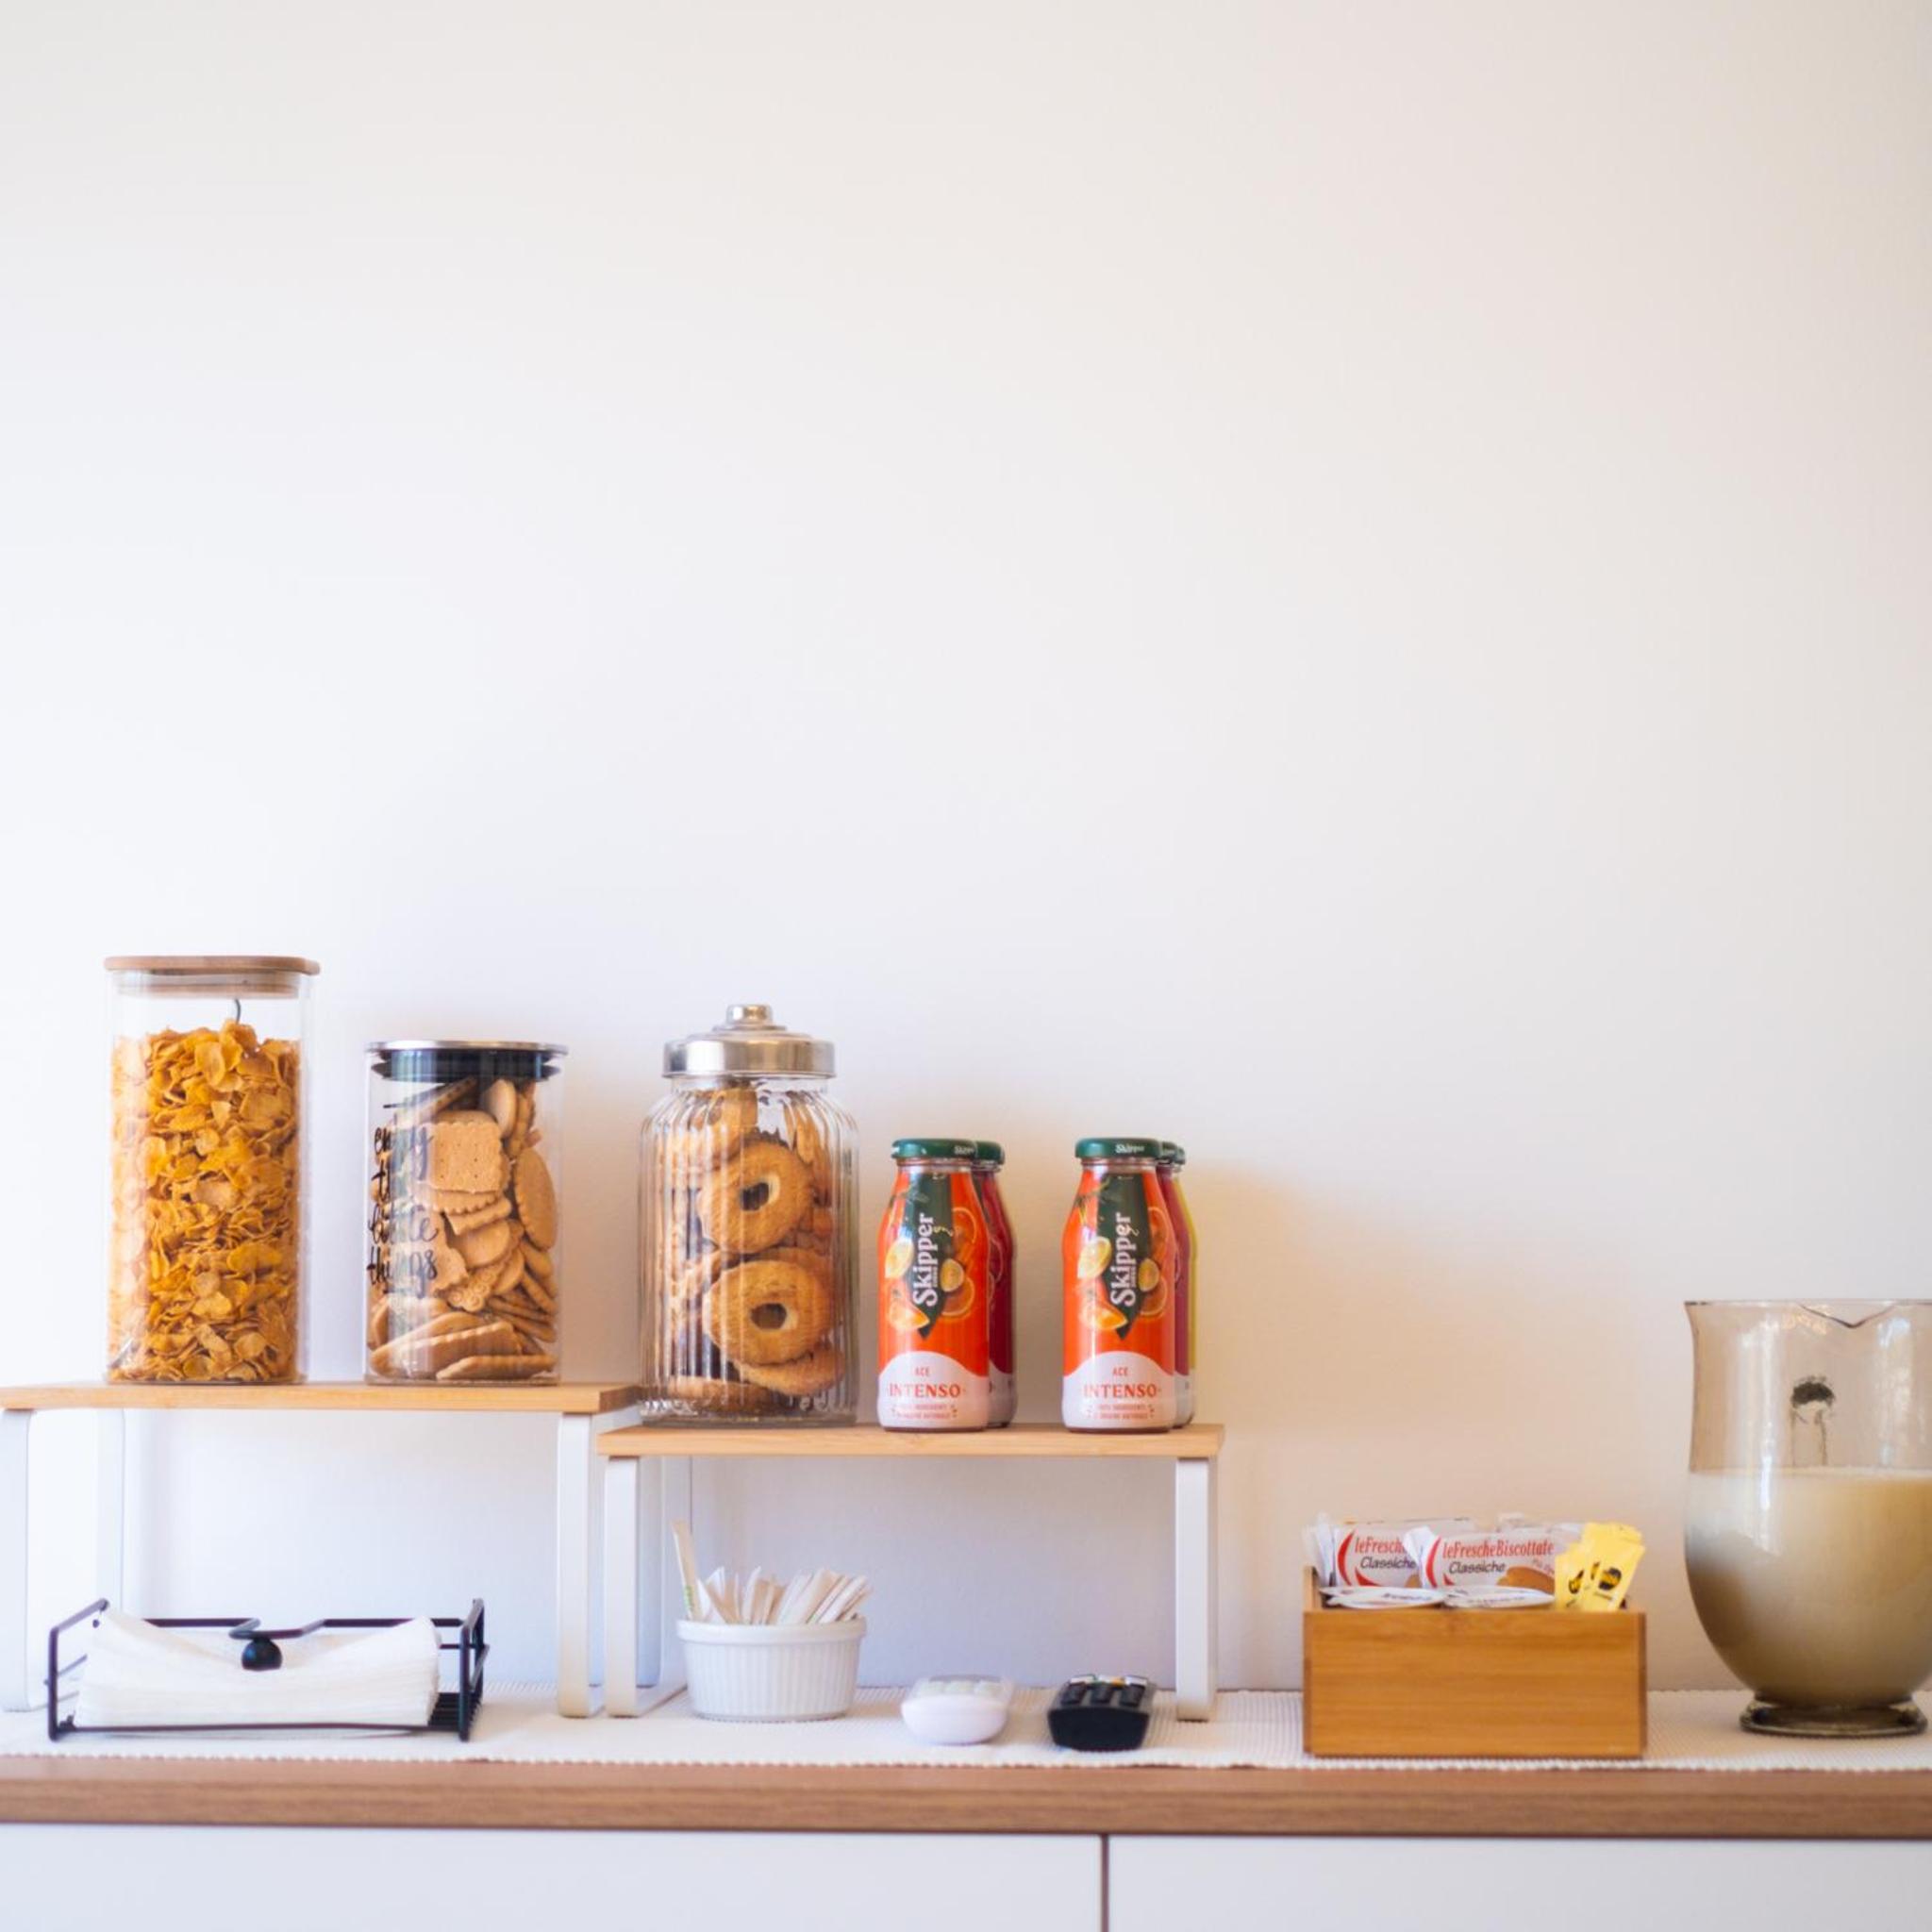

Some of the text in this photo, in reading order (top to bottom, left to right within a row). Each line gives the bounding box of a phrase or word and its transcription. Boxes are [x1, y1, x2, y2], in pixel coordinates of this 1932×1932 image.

[913, 1212, 939, 1307] Skipper
[1110, 1212, 1137, 1307] Skipper
[1112, 1367, 1128, 1376] ACE
[889, 1384, 961, 1398] INTENSO
[1083, 1384, 1158, 1398] INTENSO
[1360, 1556, 1417, 1569] Classiche
[1449, 1560, 1506, 1574] Classiche
